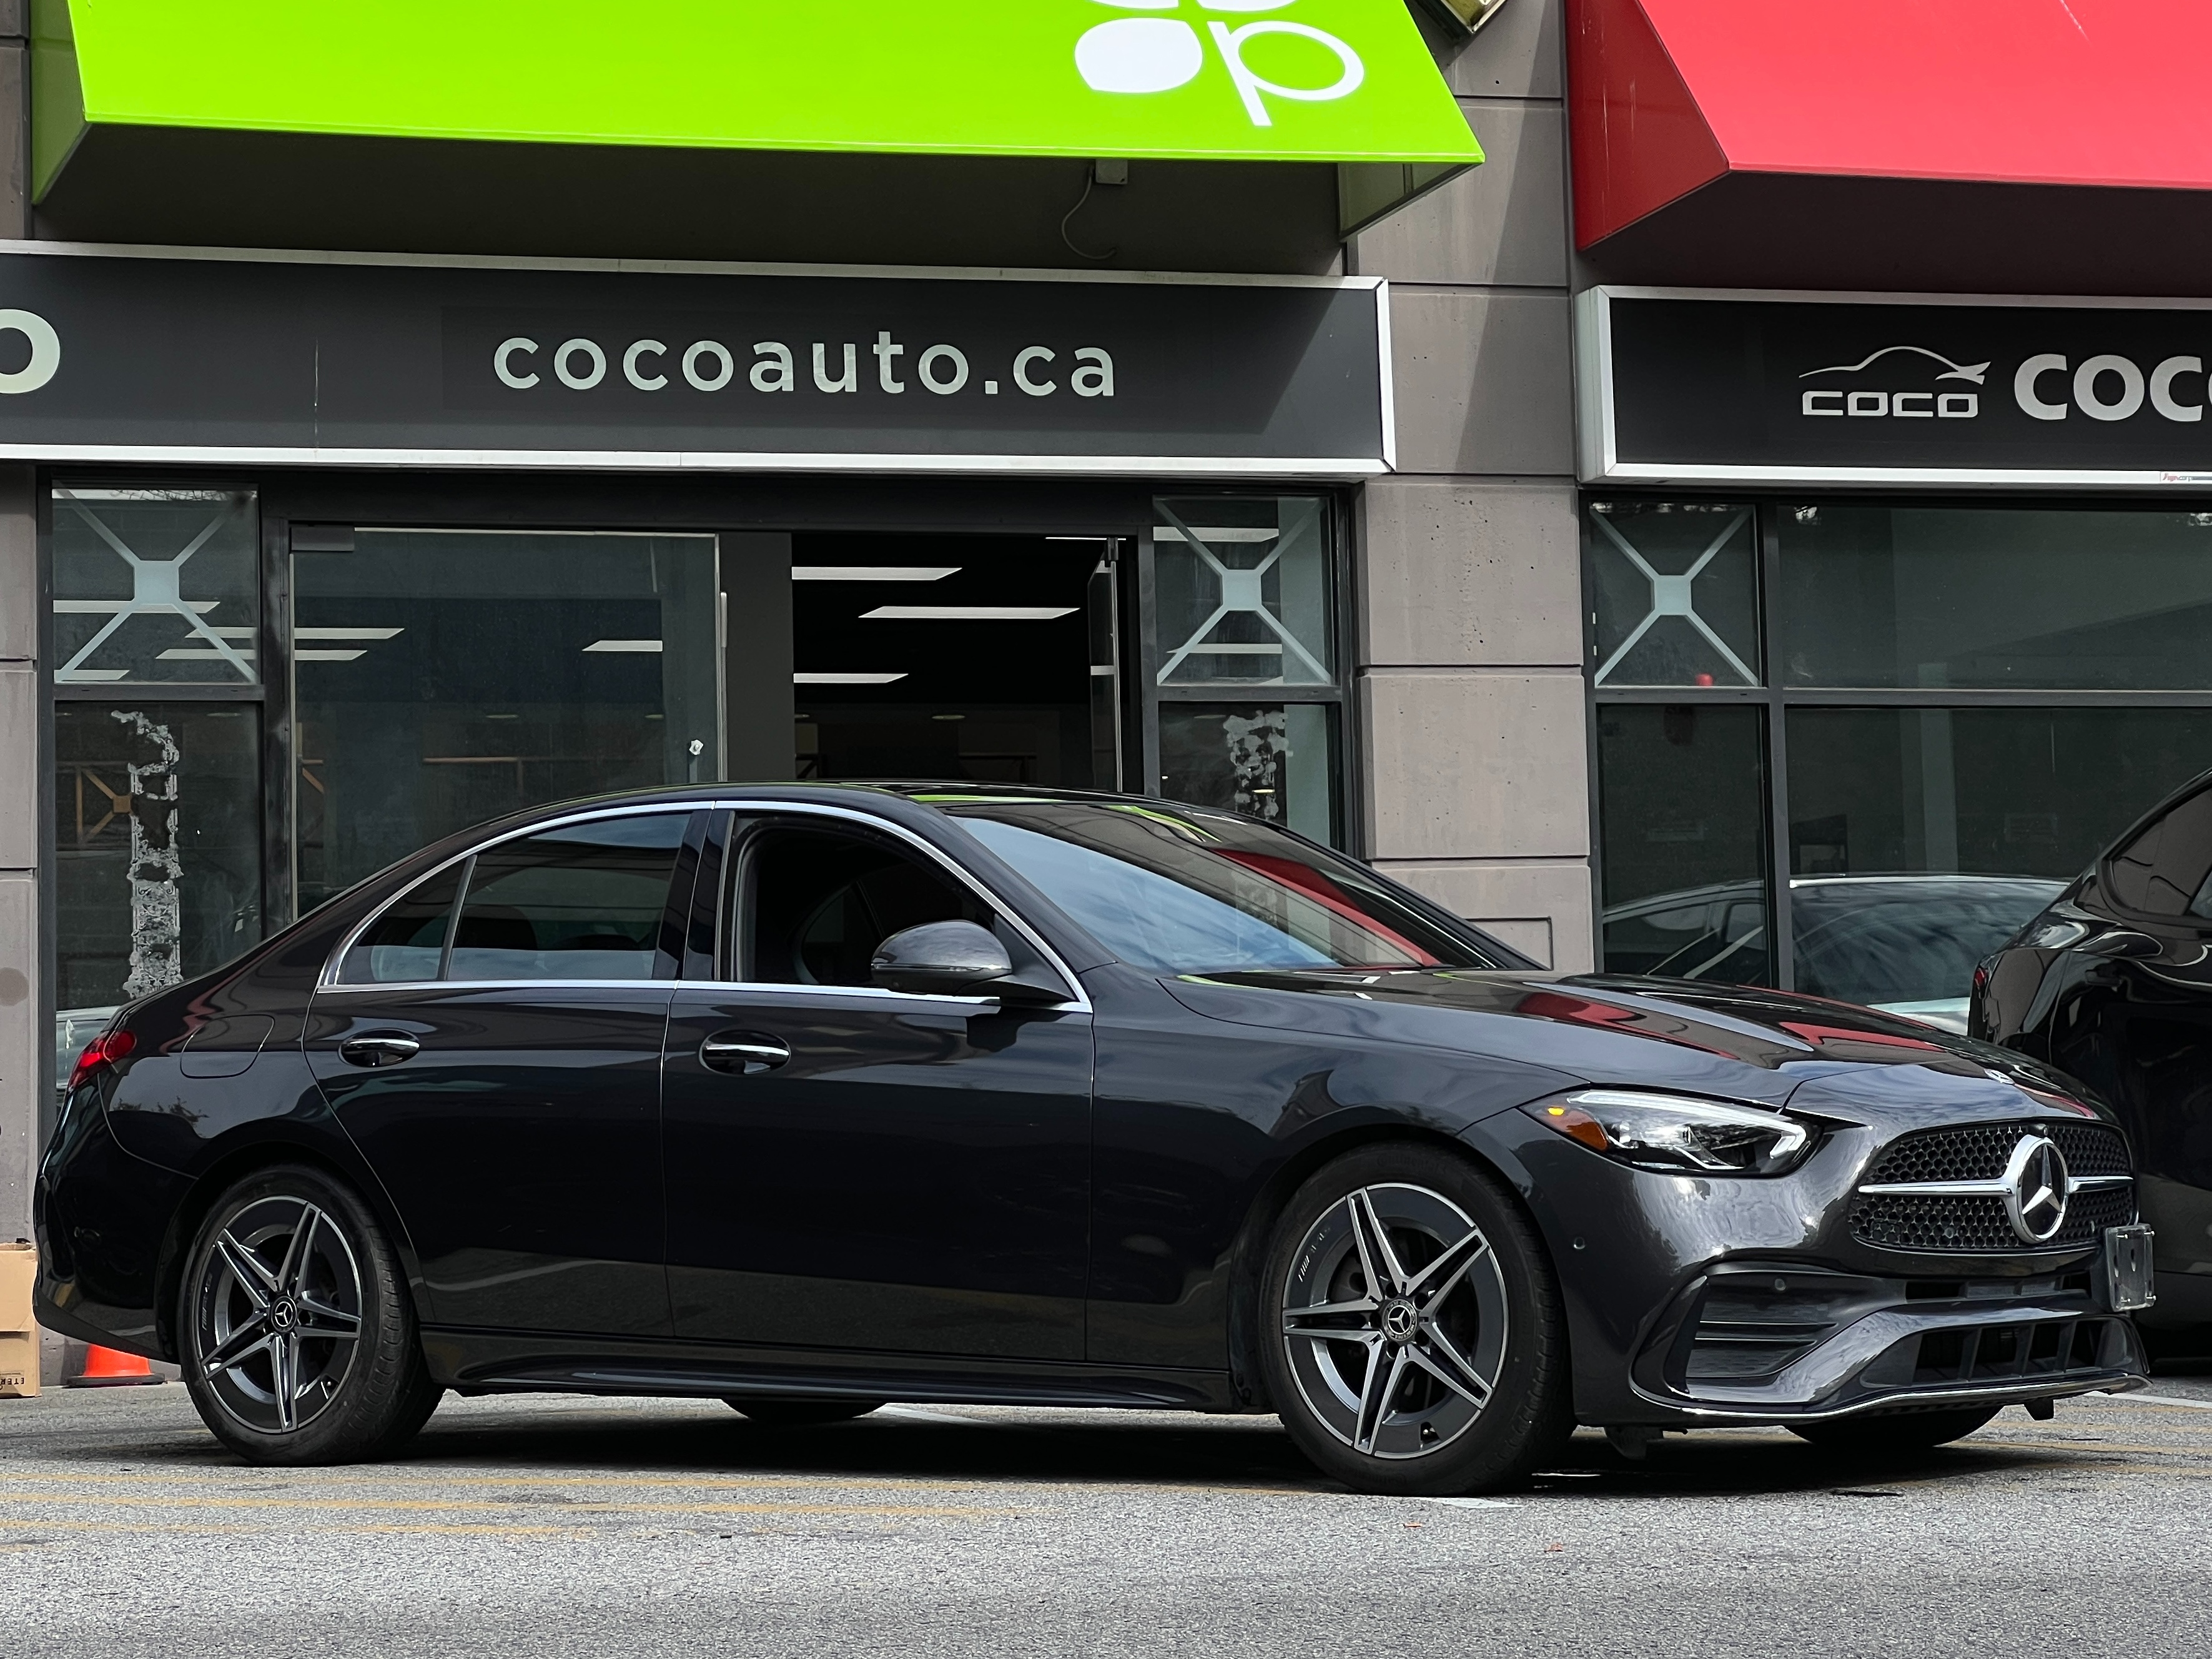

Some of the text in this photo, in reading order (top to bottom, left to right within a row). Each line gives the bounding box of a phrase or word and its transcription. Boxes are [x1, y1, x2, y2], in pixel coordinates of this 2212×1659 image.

[493, 330, 1115, 398] cocoauto.ca
[2014, 354, 2212, 422] COC
[1802, 390, 1979, 418] COCO
